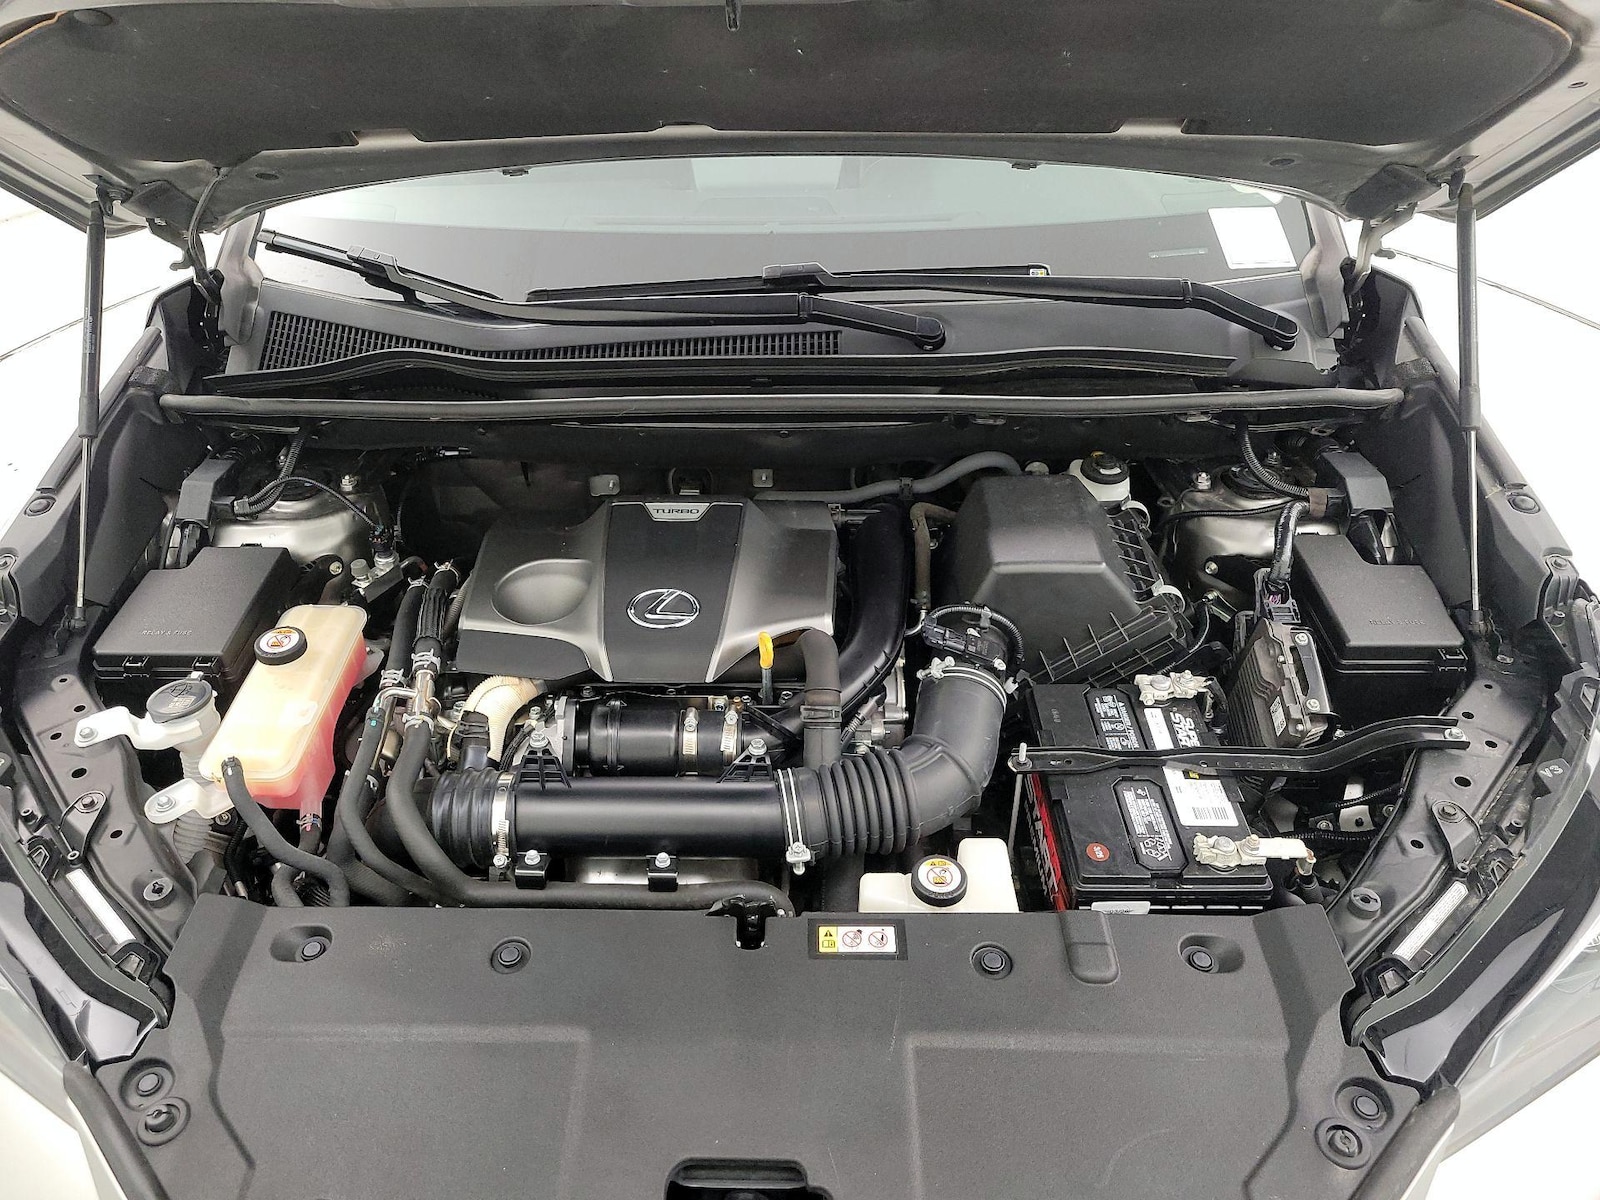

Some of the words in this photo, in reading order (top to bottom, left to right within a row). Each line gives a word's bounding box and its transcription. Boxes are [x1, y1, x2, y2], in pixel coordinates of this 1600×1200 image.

[1169, 711, 1191, 749] STAR
[1184, 717, 1201, 748] SUPE
[1540, 765, 1563, 778] V3
